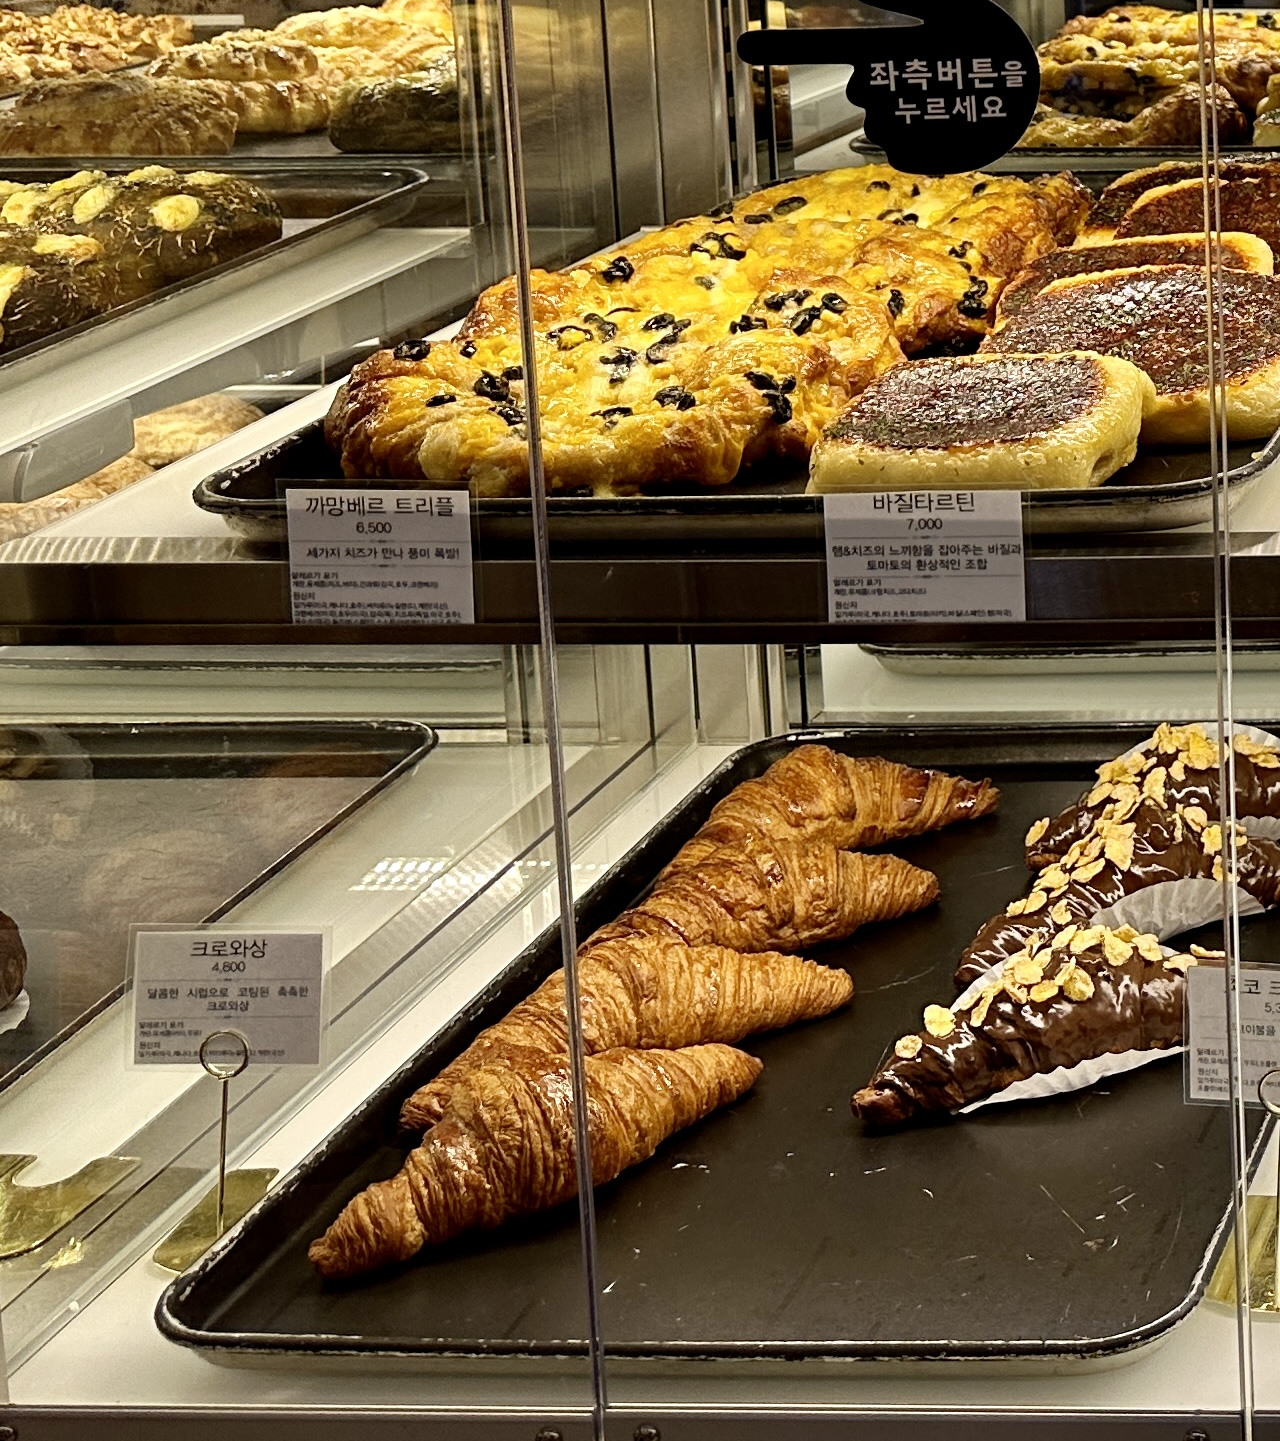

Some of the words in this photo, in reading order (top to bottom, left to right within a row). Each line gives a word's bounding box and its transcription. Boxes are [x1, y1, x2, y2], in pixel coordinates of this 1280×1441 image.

[870, 58, 1027, 91] 좌측버튼을
[895, 95, 1007, 124] 누르세요
[305, 495, 387, 517] 까망베르
[393, 496, 455, 518] 트리플
[873, 492, 976, 513] 바질타르틴
[356, 521, 392, 535] 6,500
[906, 518, 943, 532] 7,000
[306, 547, 340, 559] 세가지
[345, 547, 378, 559] 치즈가
[381, 547, 404, 559] 만나
[407, 547, 430, 559] 풍미
[832, 545, 885, 557] 햄&치즈의
[889, 545, 934, 557] 느끼함을
[938, 544, 984, 556] 잡아주는
[987, 543, 1022, 556] 바질과
[866, 559, 912, 571] 토마토의
[916, 559, 961, 571] 환상적인
[965, 559, 988, 570] 조합
[190, 939, 268, 958] 크로와상
[211, 961, 246, 974] 4,800
[147, 987, 178, 999] 달콤한
[187, 987, 229, 998] 시럽으로
[237, 987, 269, 998] 코팅된
[277, 986, 308, 997] 촉촉한
[207, 1001, 249, 1012] 크로와상
